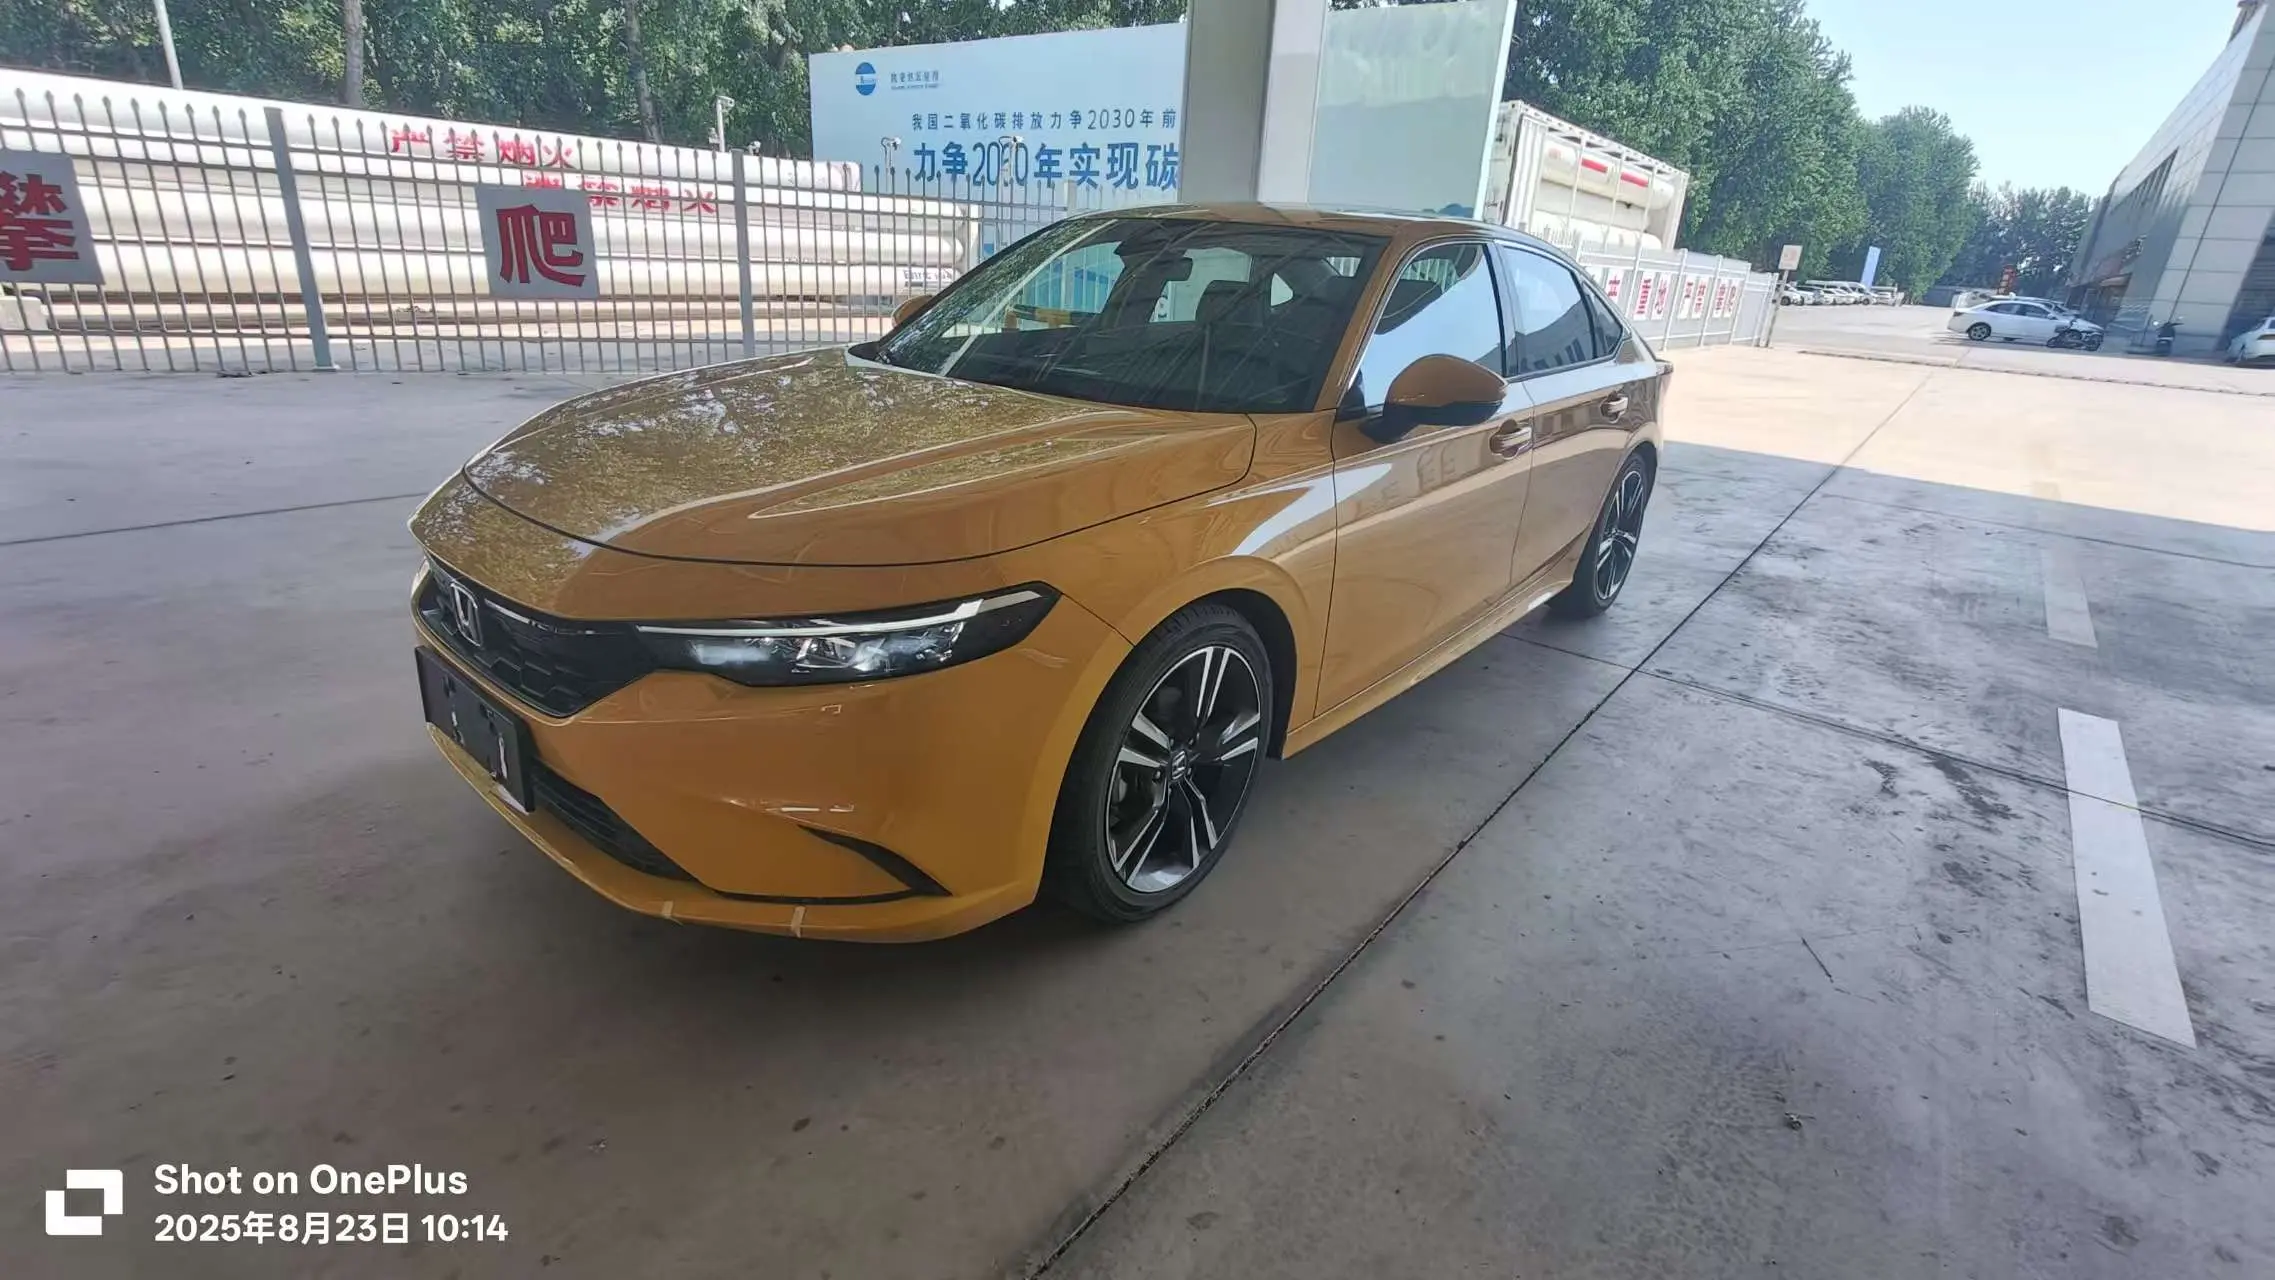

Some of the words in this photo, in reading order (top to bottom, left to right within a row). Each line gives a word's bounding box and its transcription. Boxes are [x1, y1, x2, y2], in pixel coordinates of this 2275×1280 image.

[911, 108, 1177, 132] 我国二氧化碳排放力争2030年前
[391, 129, 574, 169] 严禁烟火
[496, 204, 586, 287] 爬
